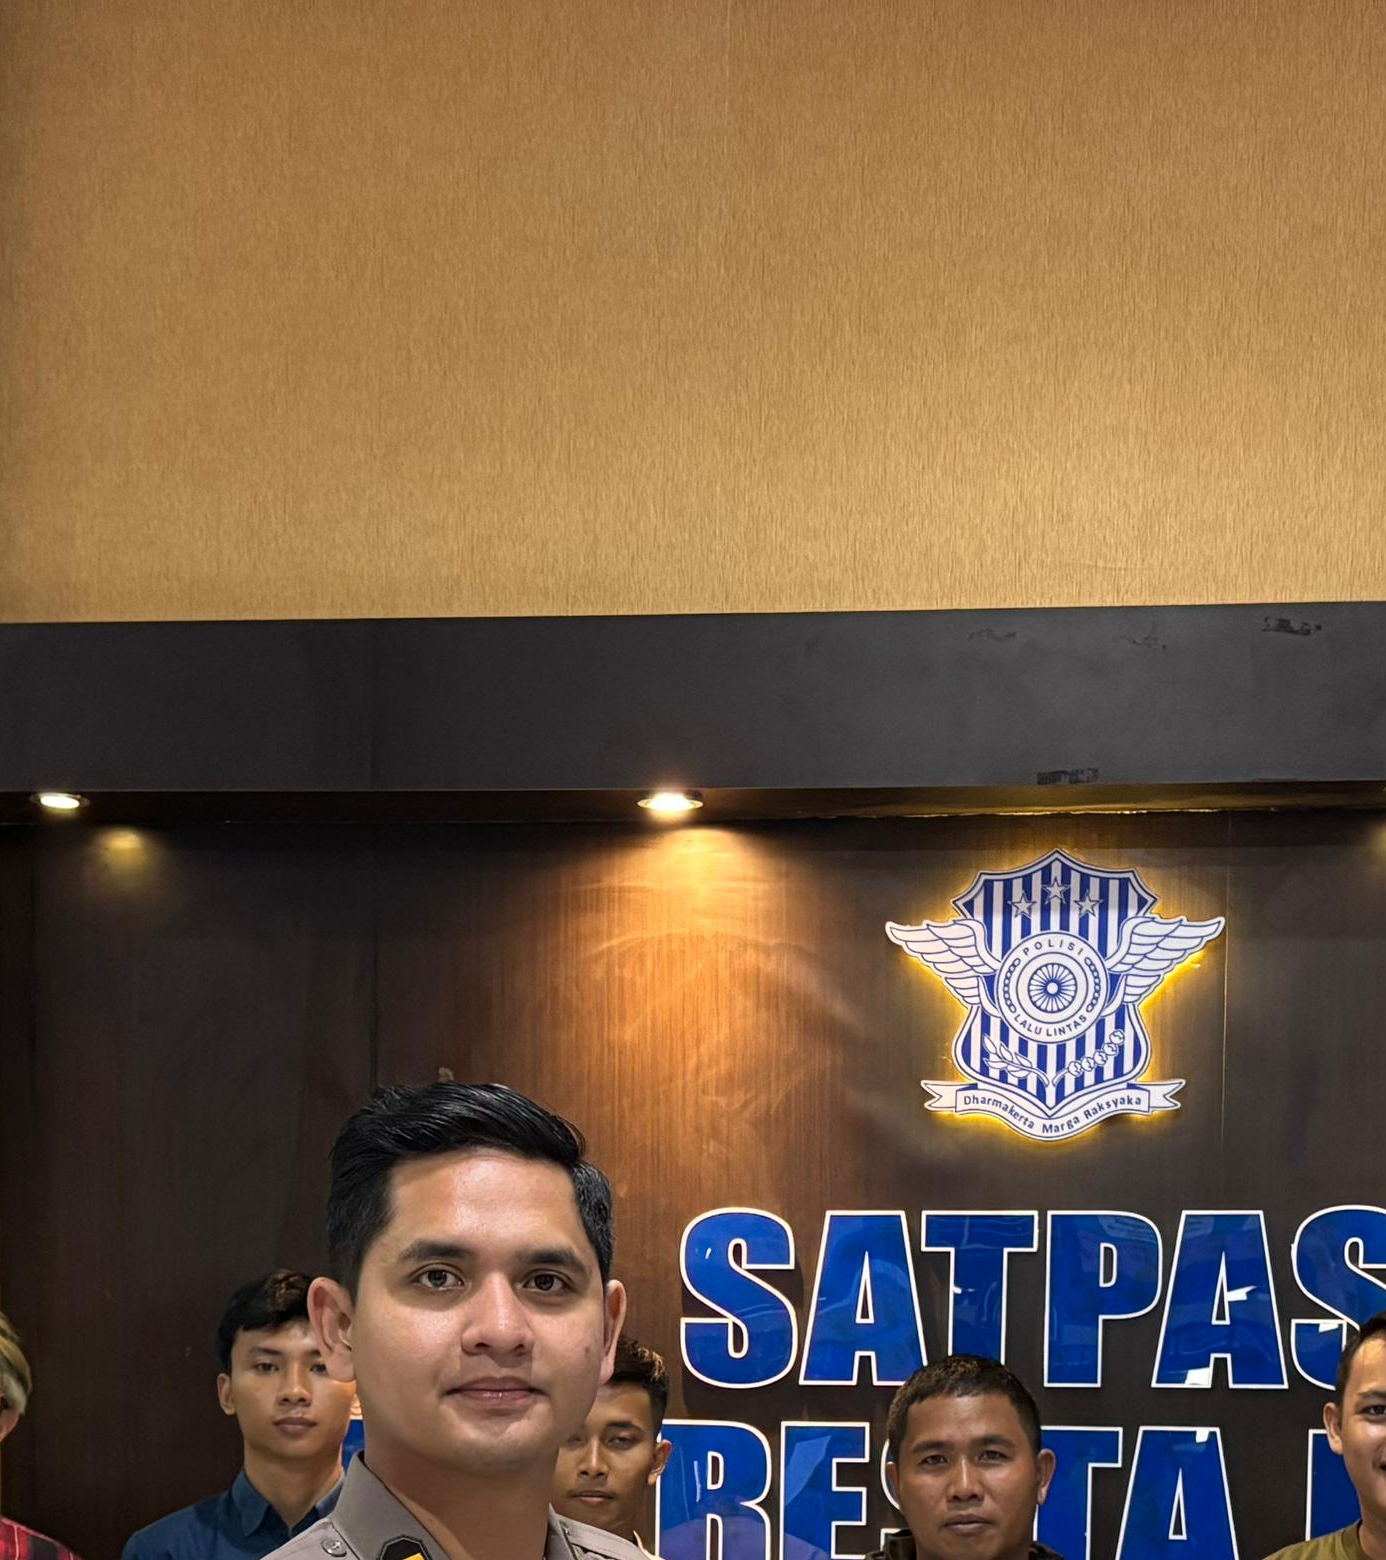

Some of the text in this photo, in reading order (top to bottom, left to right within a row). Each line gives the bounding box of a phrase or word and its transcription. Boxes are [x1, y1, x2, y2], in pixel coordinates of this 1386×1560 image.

[1023, 938, 1085, 957] POLISI
[1013, 1012, 1088, 1038] LALU LINTAS
[963, 1094, 1142, 1135] Dharmakerta Marga Raksyaka
